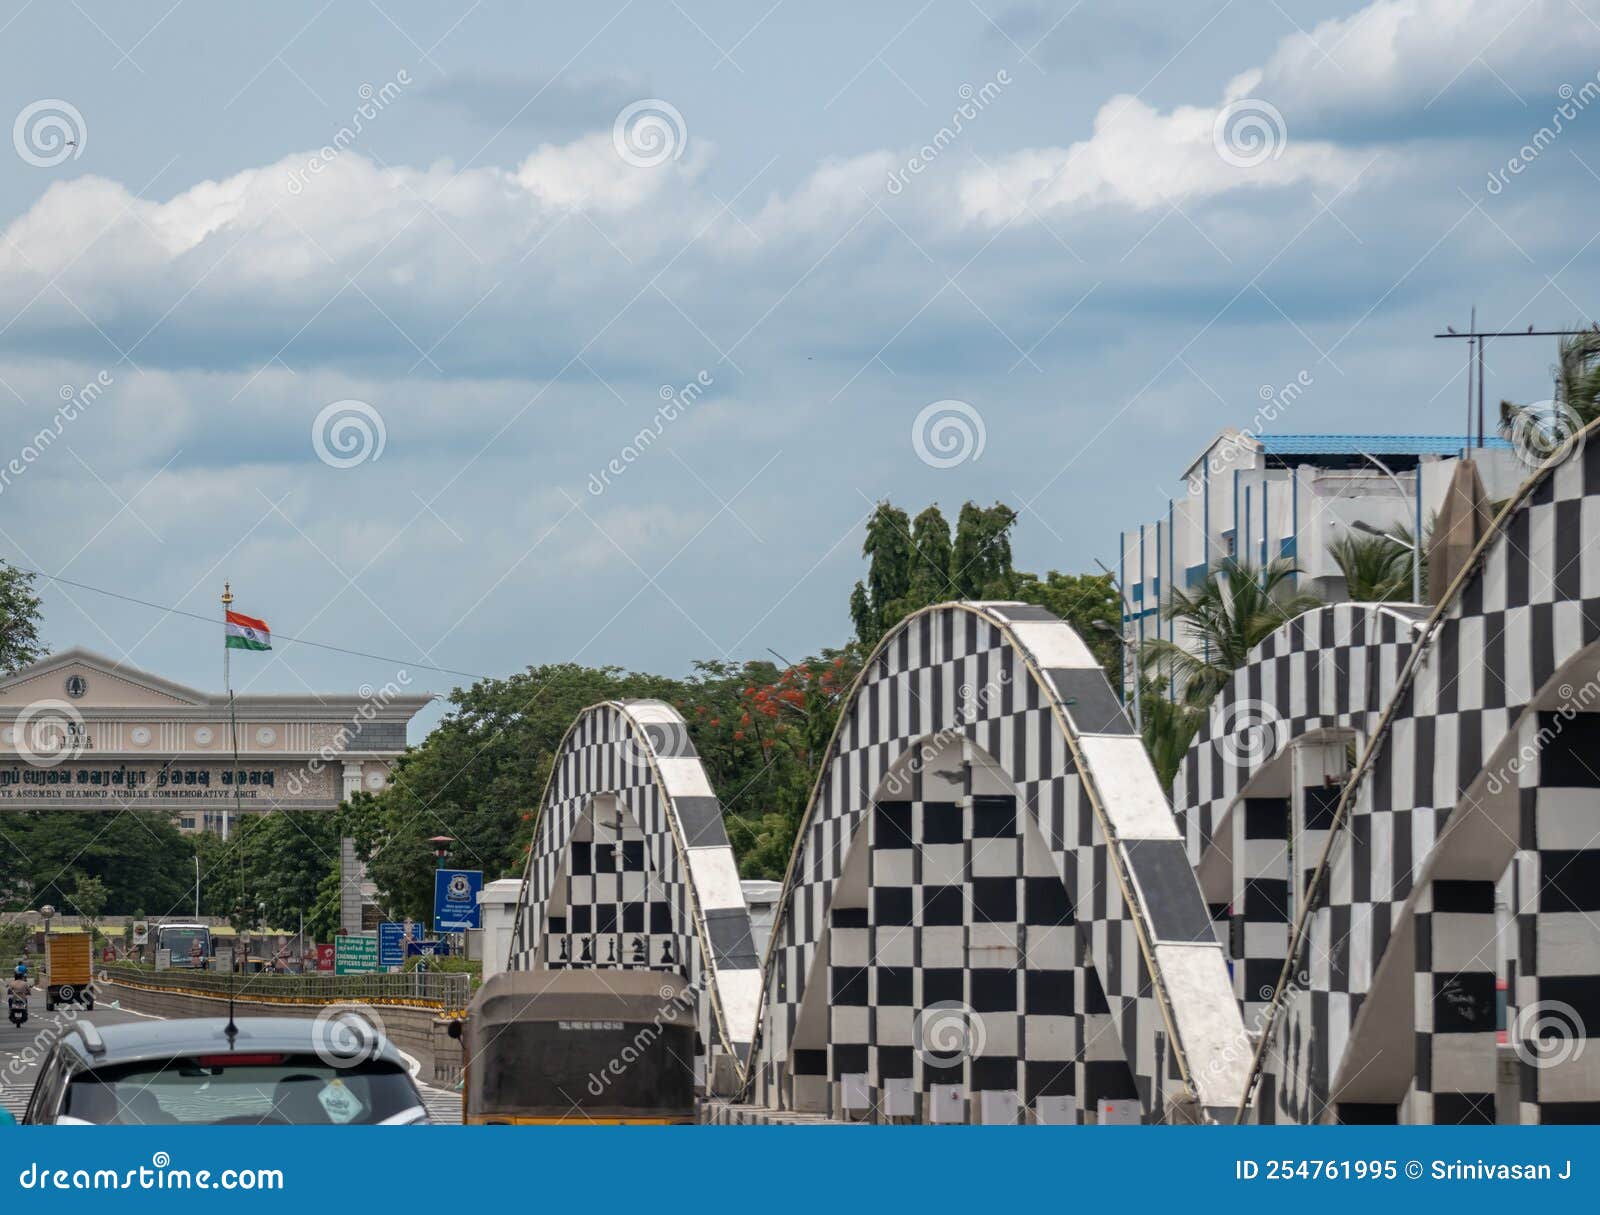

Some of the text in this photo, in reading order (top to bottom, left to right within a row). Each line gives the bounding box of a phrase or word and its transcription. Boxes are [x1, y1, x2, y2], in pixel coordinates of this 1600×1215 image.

[17, 790, 62, 798] ASSEMBLY
[66, 790, 108, 798] DIAMOND
[112, 790, 149, 799] JUBILEE
[153, 790, 229, 798] COMMEMORATIVE
[233, 790, 257, 798] ARCH
